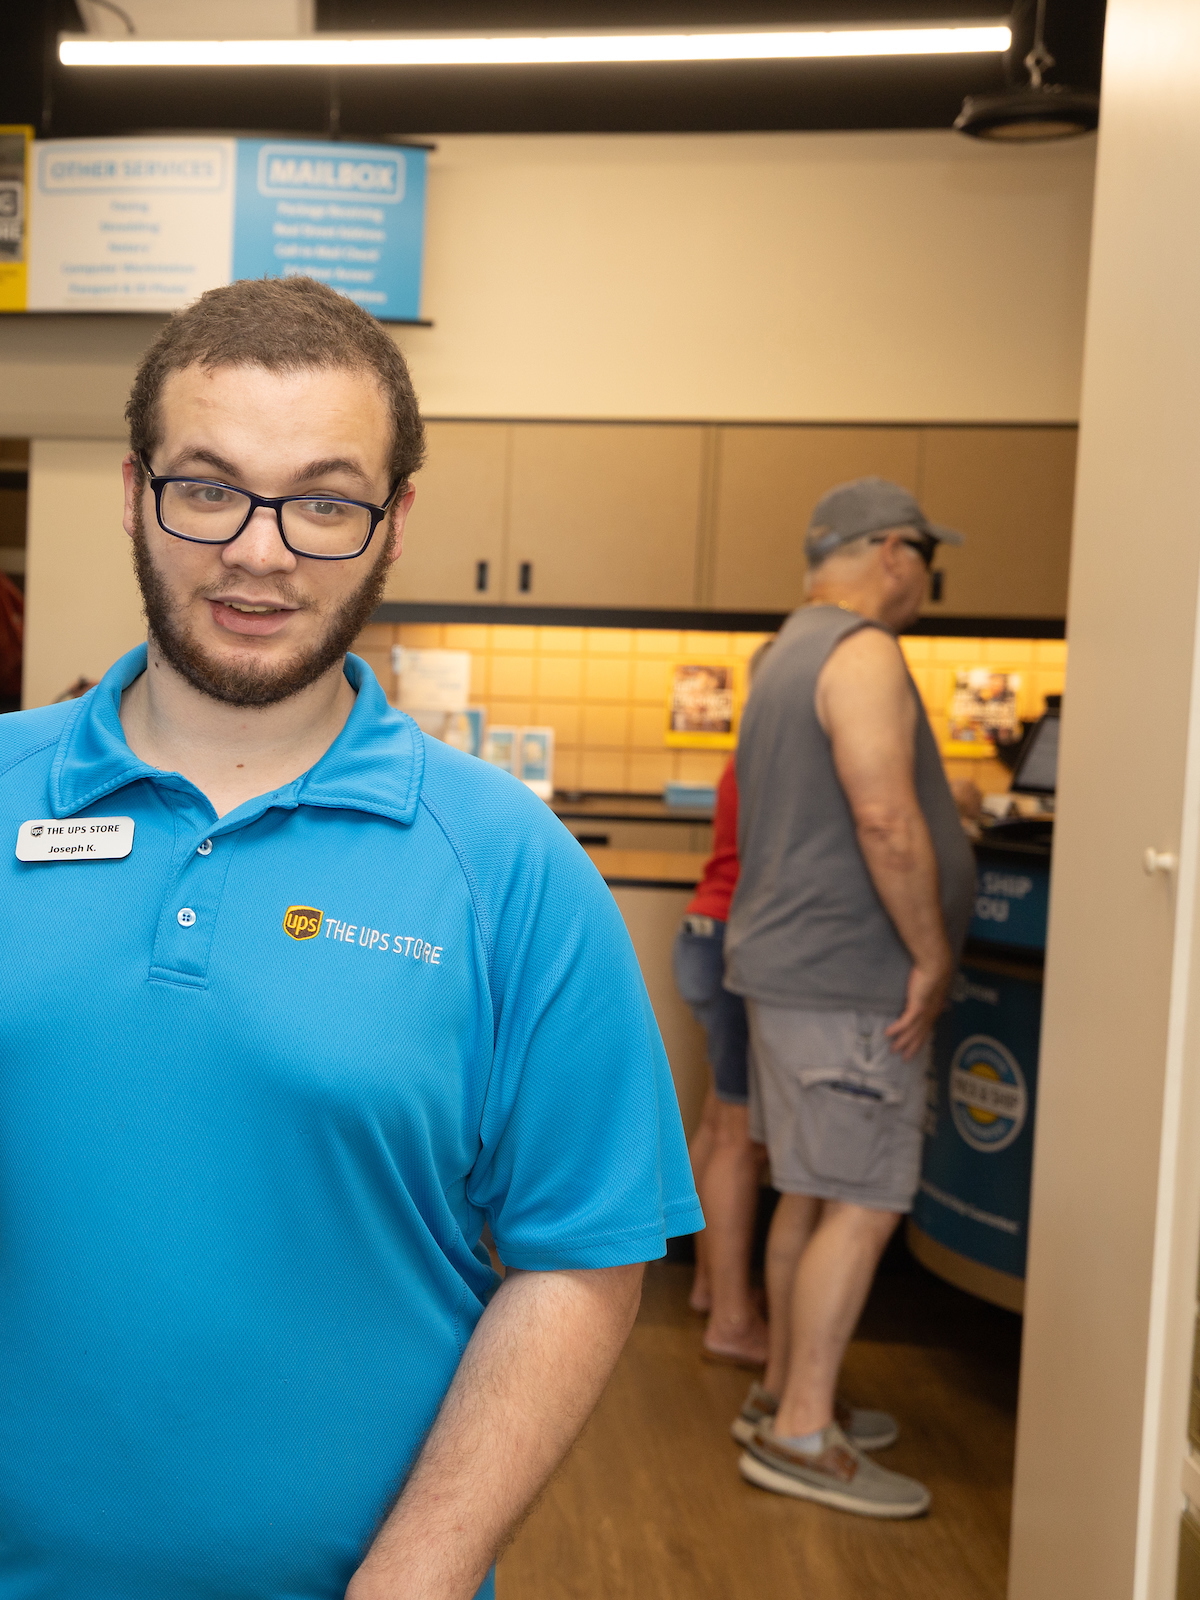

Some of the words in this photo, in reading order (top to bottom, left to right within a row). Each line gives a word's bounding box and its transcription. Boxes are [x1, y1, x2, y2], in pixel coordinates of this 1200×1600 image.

[122, 159, 214, 177] SERVICES
[270, 159, 393, 189] MAILBOX
[47, 827, 64, 835] THE
[68, 826, 87, 834] UPS
[90, 824, 120, 833] STORE
[48, 844, 84, 854] Joseph
[86, 844, 96, 852] K.
[975, 896, 1009, 922] OU
[287, 913, 317, 935] ups
[326, 918, 357, 943] THE
[359, 926, 390, 951] UPS
[392, 936, 443, 964] STORE
